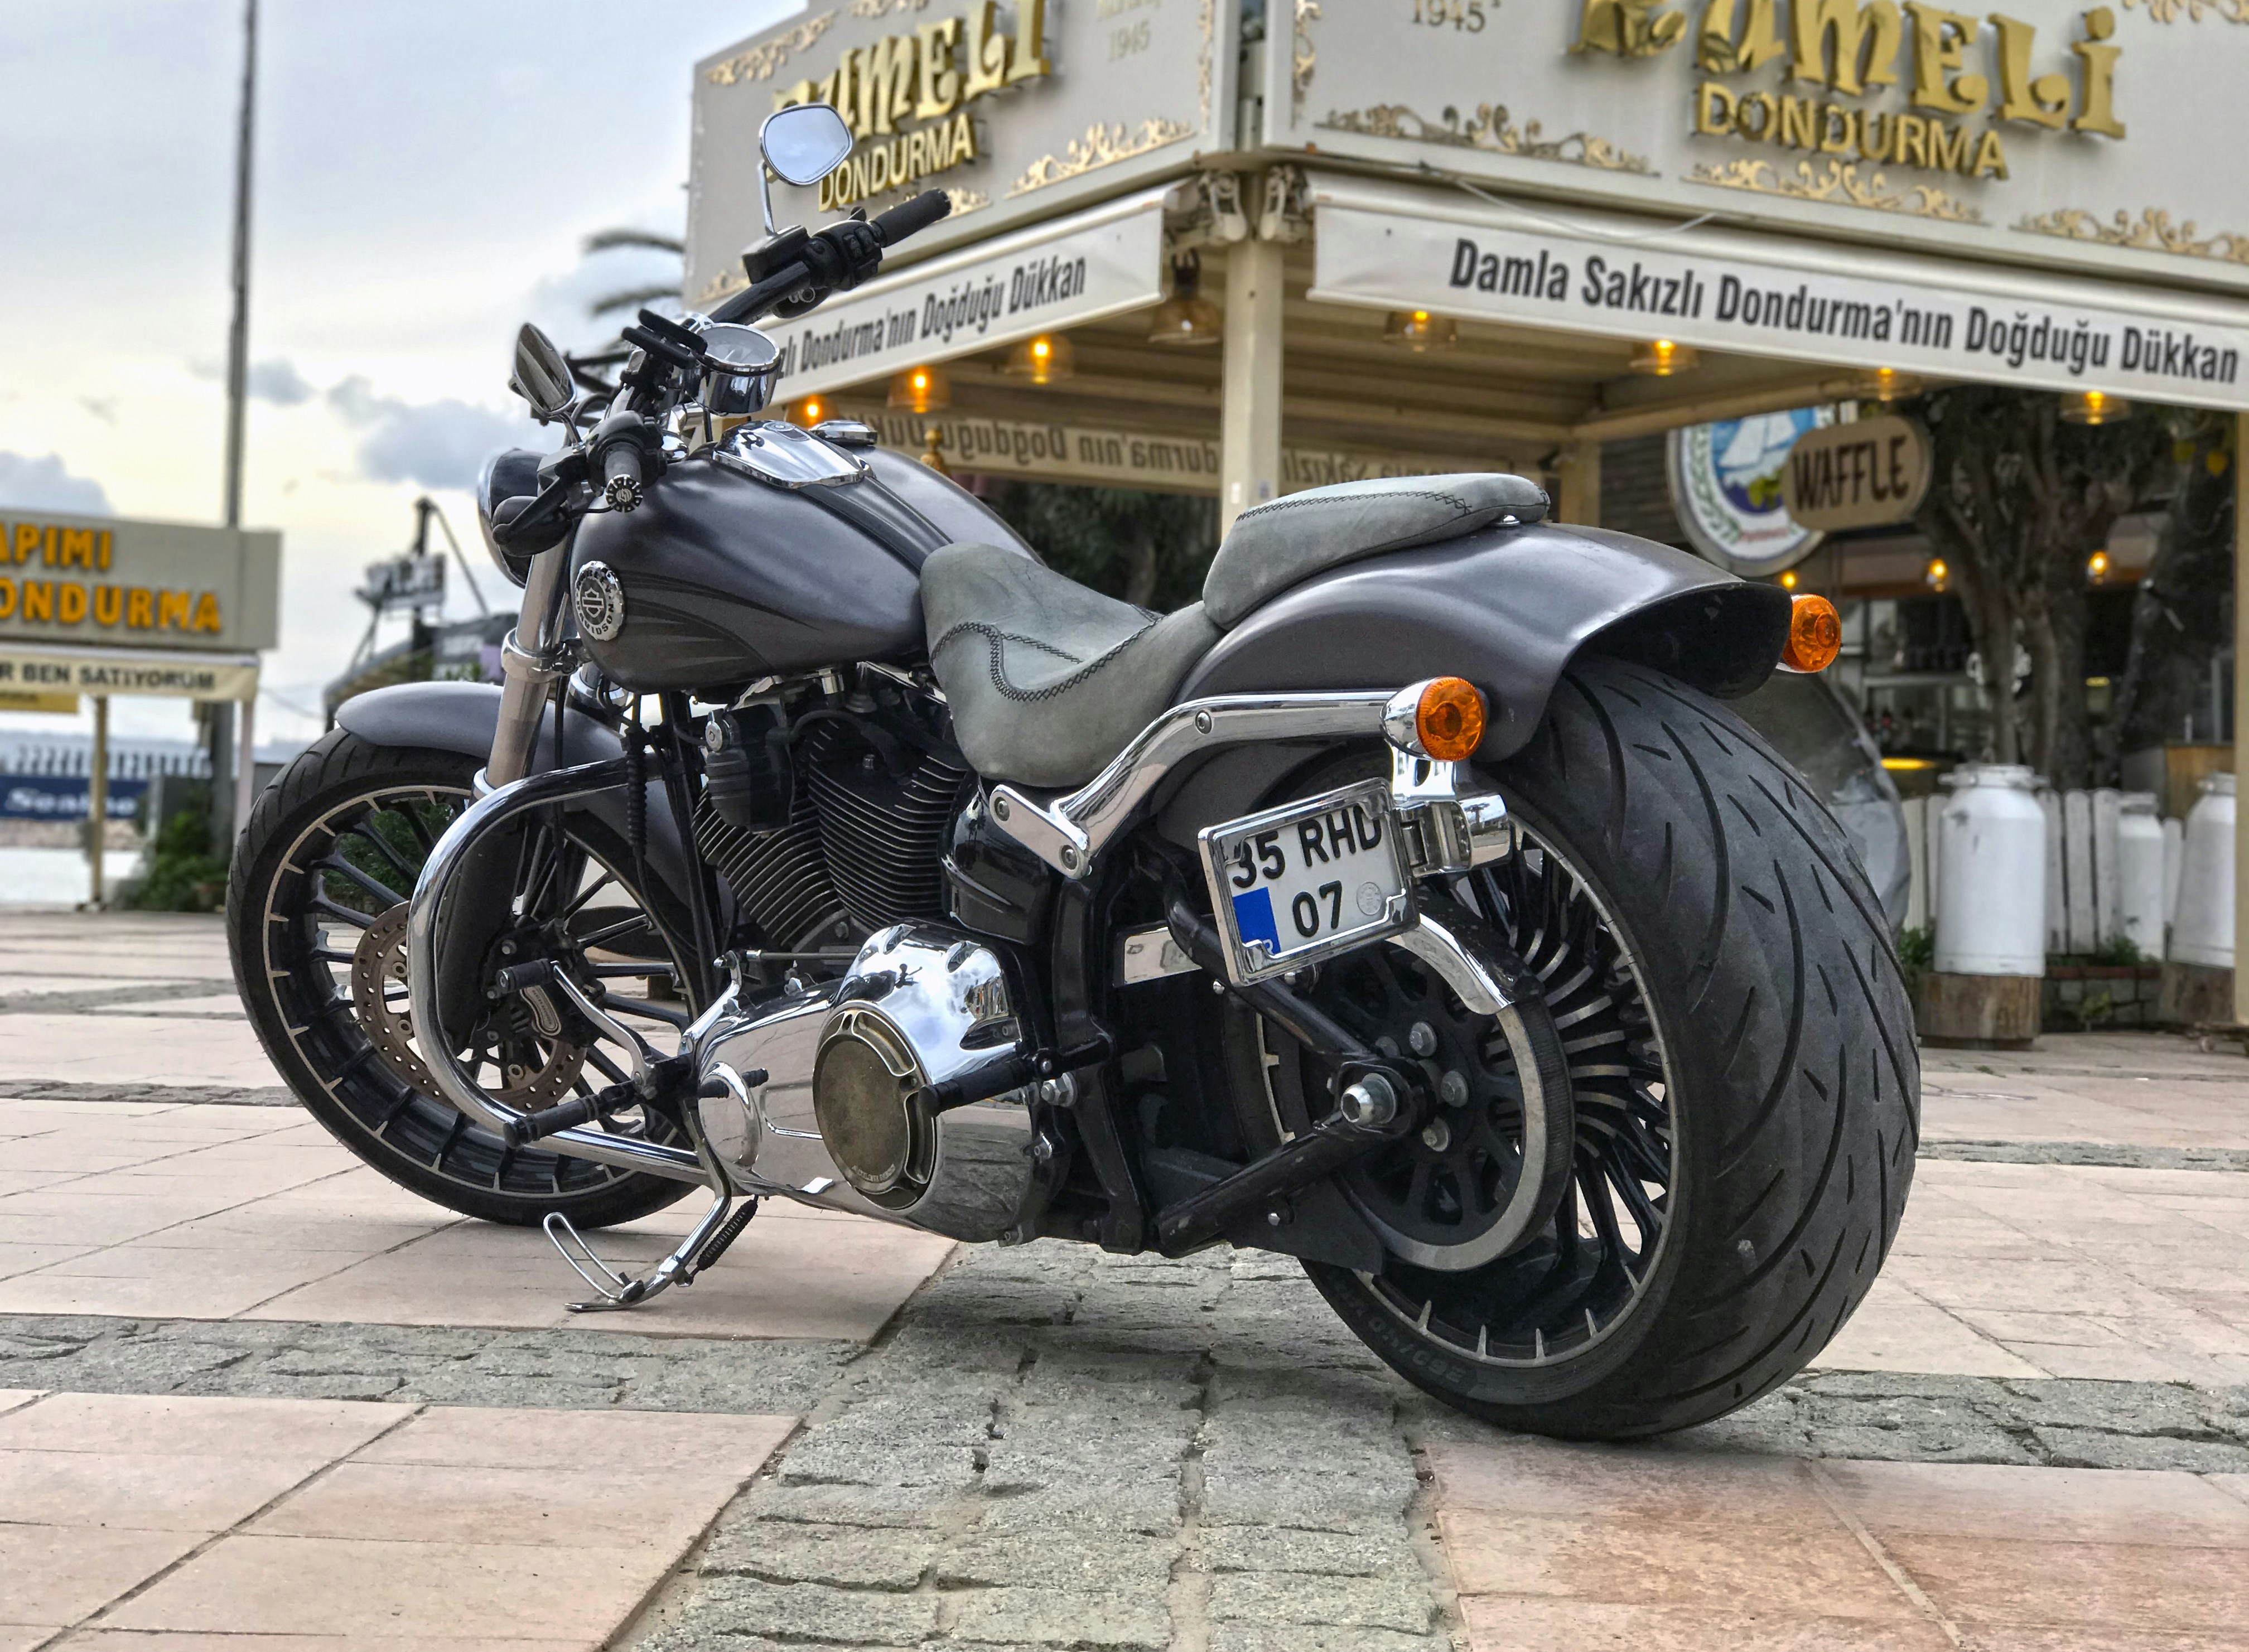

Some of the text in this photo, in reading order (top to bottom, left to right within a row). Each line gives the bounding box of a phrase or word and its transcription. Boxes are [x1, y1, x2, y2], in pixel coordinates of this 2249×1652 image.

[818, 113, 974, 212] DONDURMA
[1697, 82, 2009, 180] DONDURMA
[921, 273, 1005, 344] Doğduğu
[1009, 255, 1087, 314] Dükkan
[1450, 239, 2238, 384] Damla Sakızlı Dondurma'nın Doğduğu Dükkan
[1792, 434, 1908, 512] WAFFLE
[23, 663, 71, 684] BEN
[1233, 805, 1382, 888] 35 RHD
[1292, 880, 1343, 938] 07
